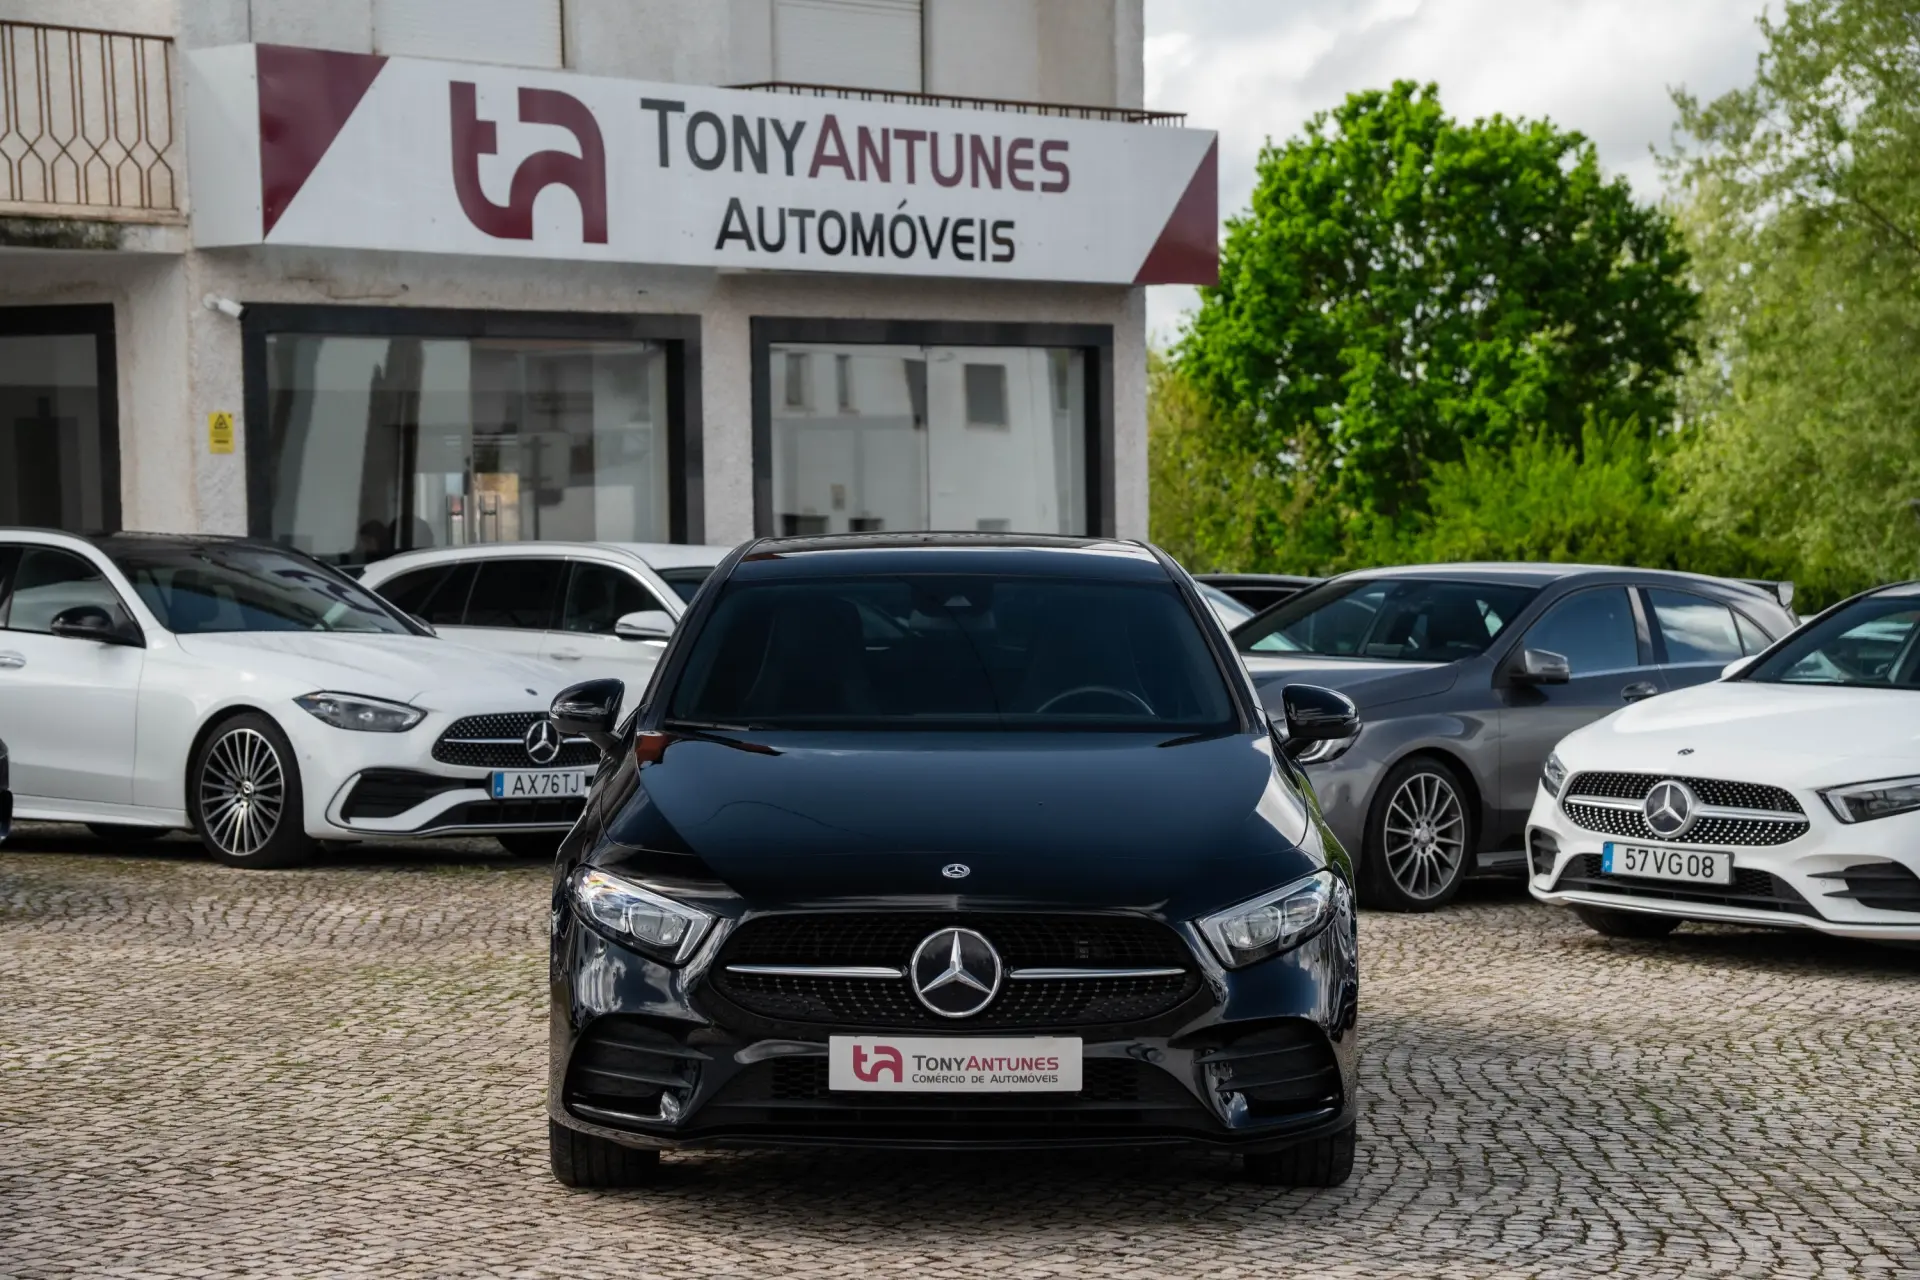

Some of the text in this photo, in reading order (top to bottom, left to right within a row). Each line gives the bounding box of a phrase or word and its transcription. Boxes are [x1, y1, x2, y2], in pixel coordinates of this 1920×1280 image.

[715, 198, 1015, 263] AUTOMÓVEIS
[912, 1072, 1059, 1084] COMÉRCIO DE AUTOMÓVEIS
